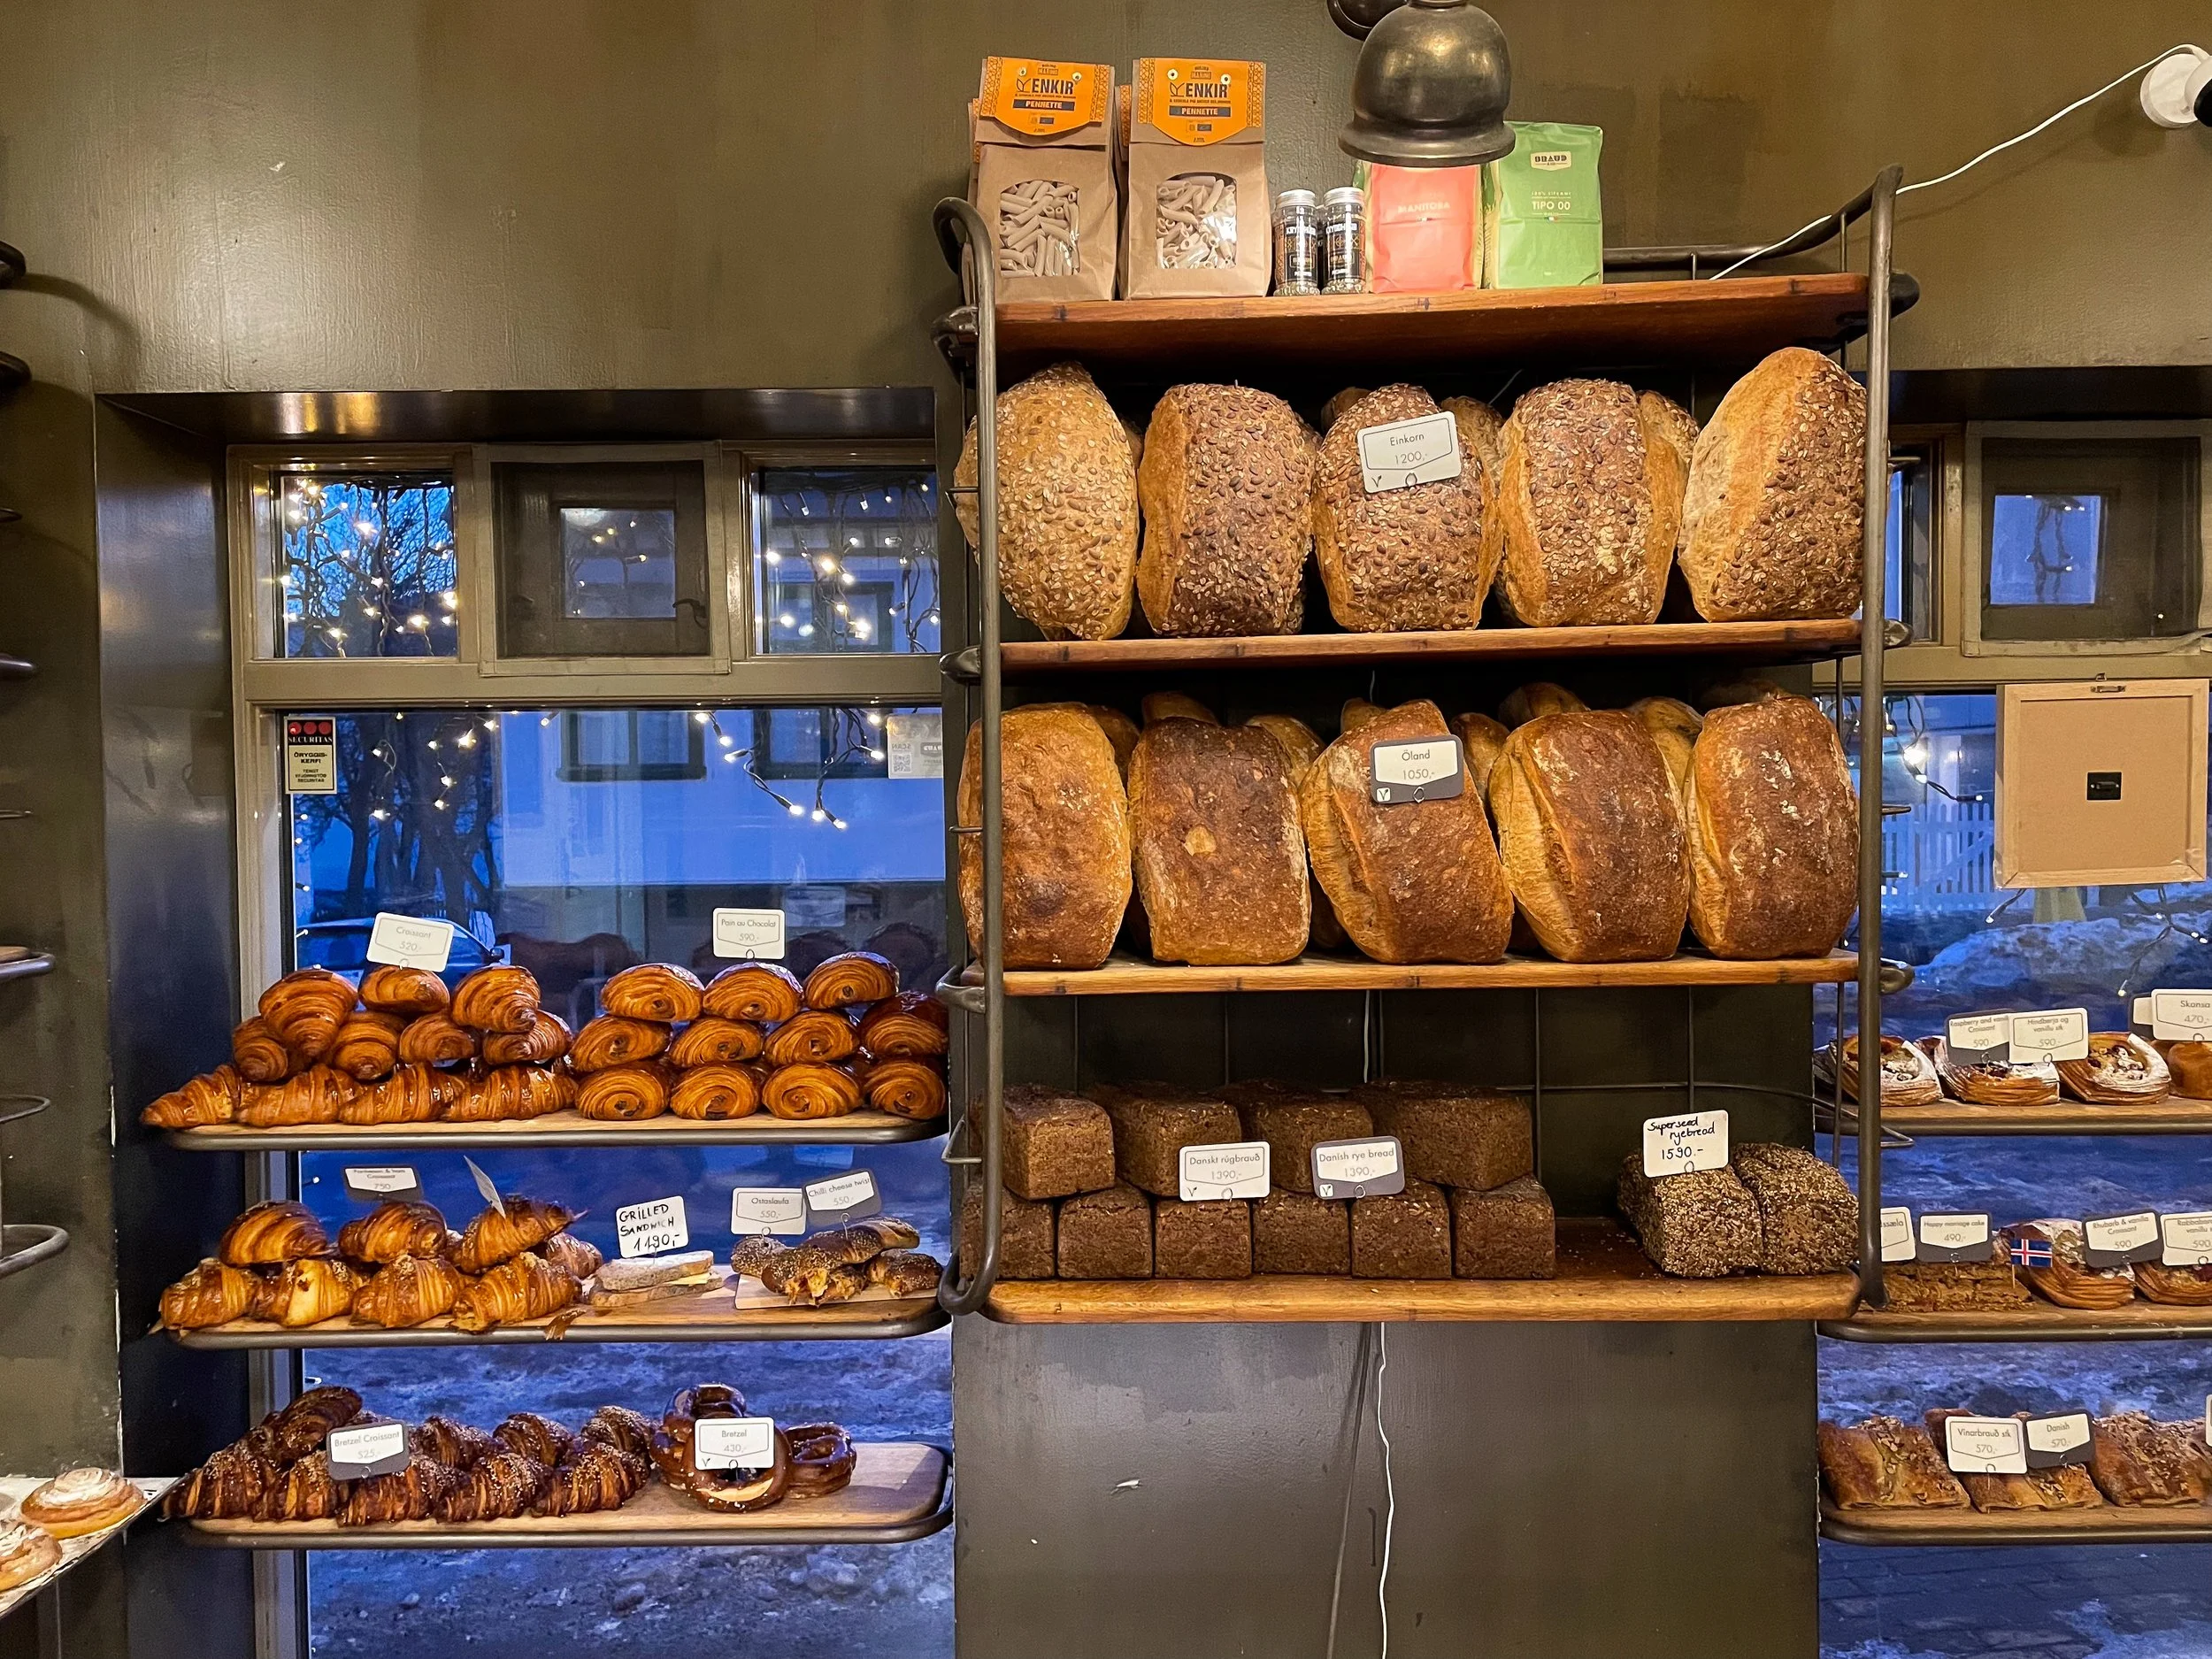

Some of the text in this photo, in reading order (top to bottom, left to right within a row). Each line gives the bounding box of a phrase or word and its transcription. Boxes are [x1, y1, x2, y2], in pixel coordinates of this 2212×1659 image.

[1025, 100, 1063, 109] PENNETTE
[1532, 201, 1571, 211] TIPO 00
[1389, 434, 1425, 446] Einkorn
[1402, 749, 1431, 761] Öland
[396, 926, 432, 939] Croissant
[1647, 1116, 1699, 1136] Superseed
[1670, 1121, 1716, 1146] ryebread
[1189, 1153, 1261, 1165] Danskt rúgbrauð
[1319, 1148, 1394, 1163] Danish rye bread
[808, 1178, 870, 1197] Chilli cheese twist
[620, 1216, 674, 1237] SANDWICH
[2093, 1219, 2120, 1229] Rhubarb
[2107, 1225, 2137, 1235] Croissant
[2047, 1422, 2070, 1432] Danish
[334, 1431, 400, 1448] Bretzel Croissant
[721, 1429, 748, 1438] Bretzel
[2001, 1429, 2011, 1438] stk
